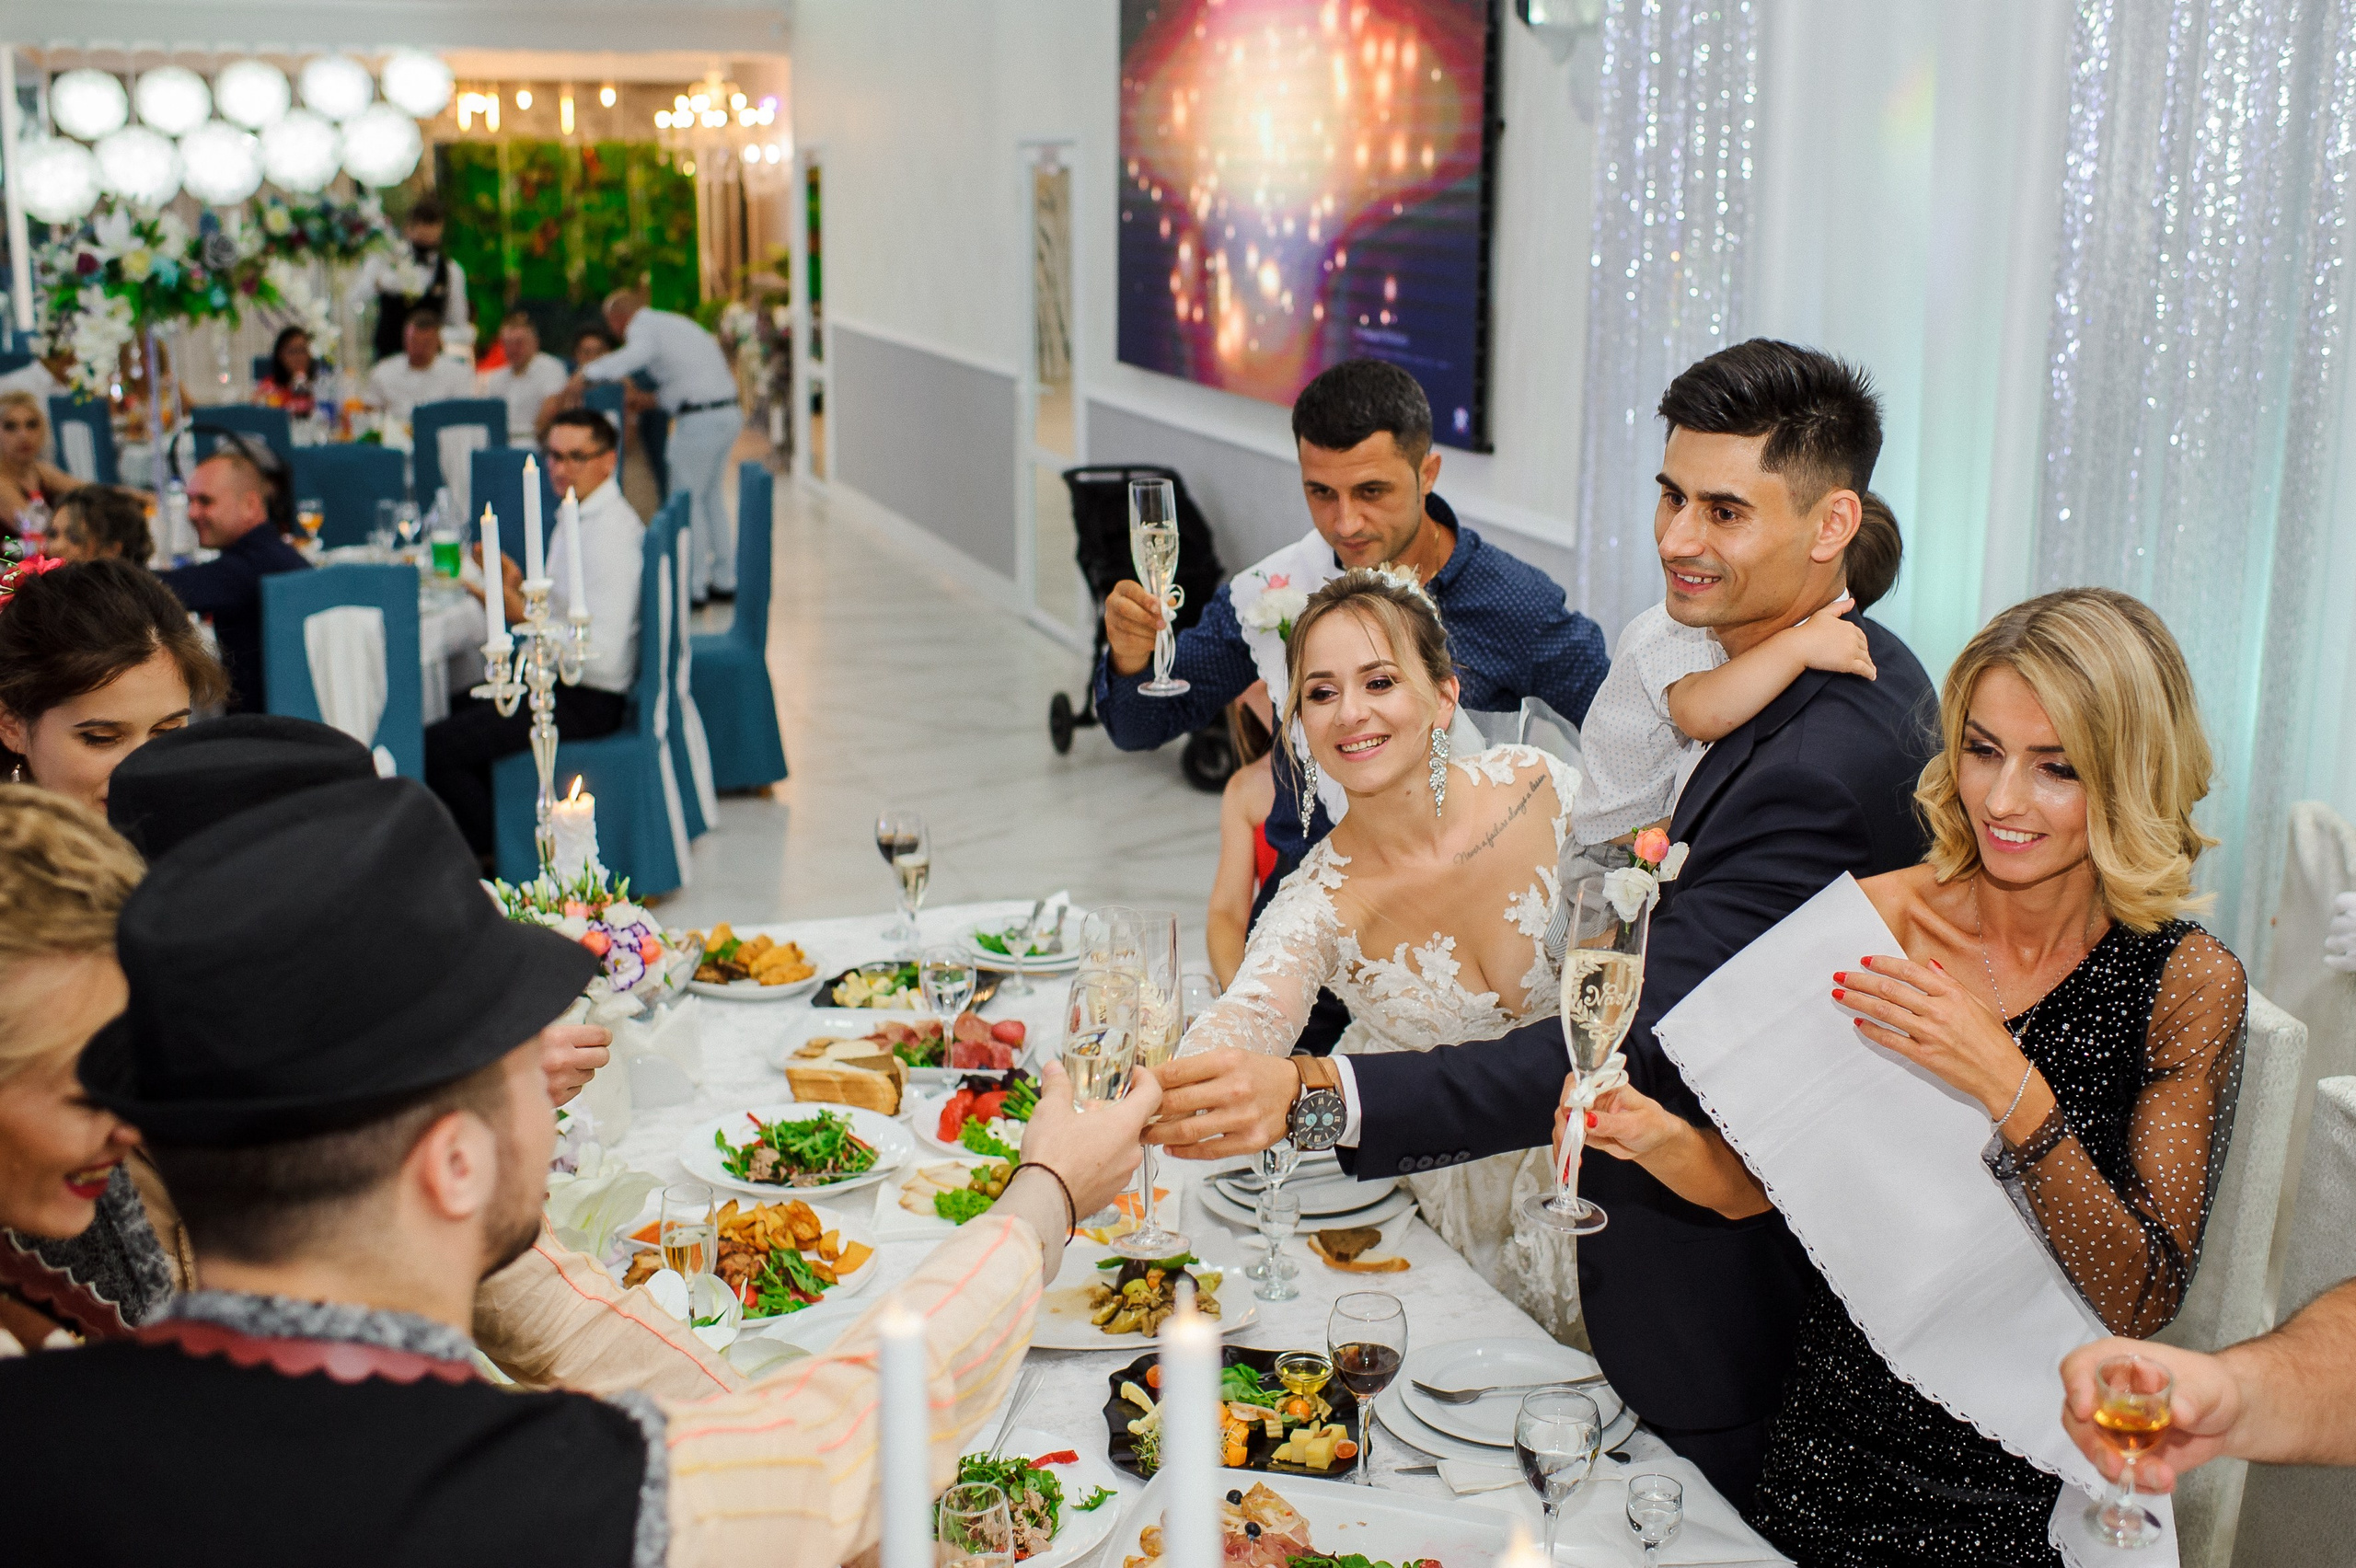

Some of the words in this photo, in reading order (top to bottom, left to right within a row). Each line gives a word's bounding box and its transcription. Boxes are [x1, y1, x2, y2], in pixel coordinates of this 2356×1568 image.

[1453, 845, 1482, 864] Never
[1485, 819, 1508, 847] failure
[1508, 797, 1527, 821] always
